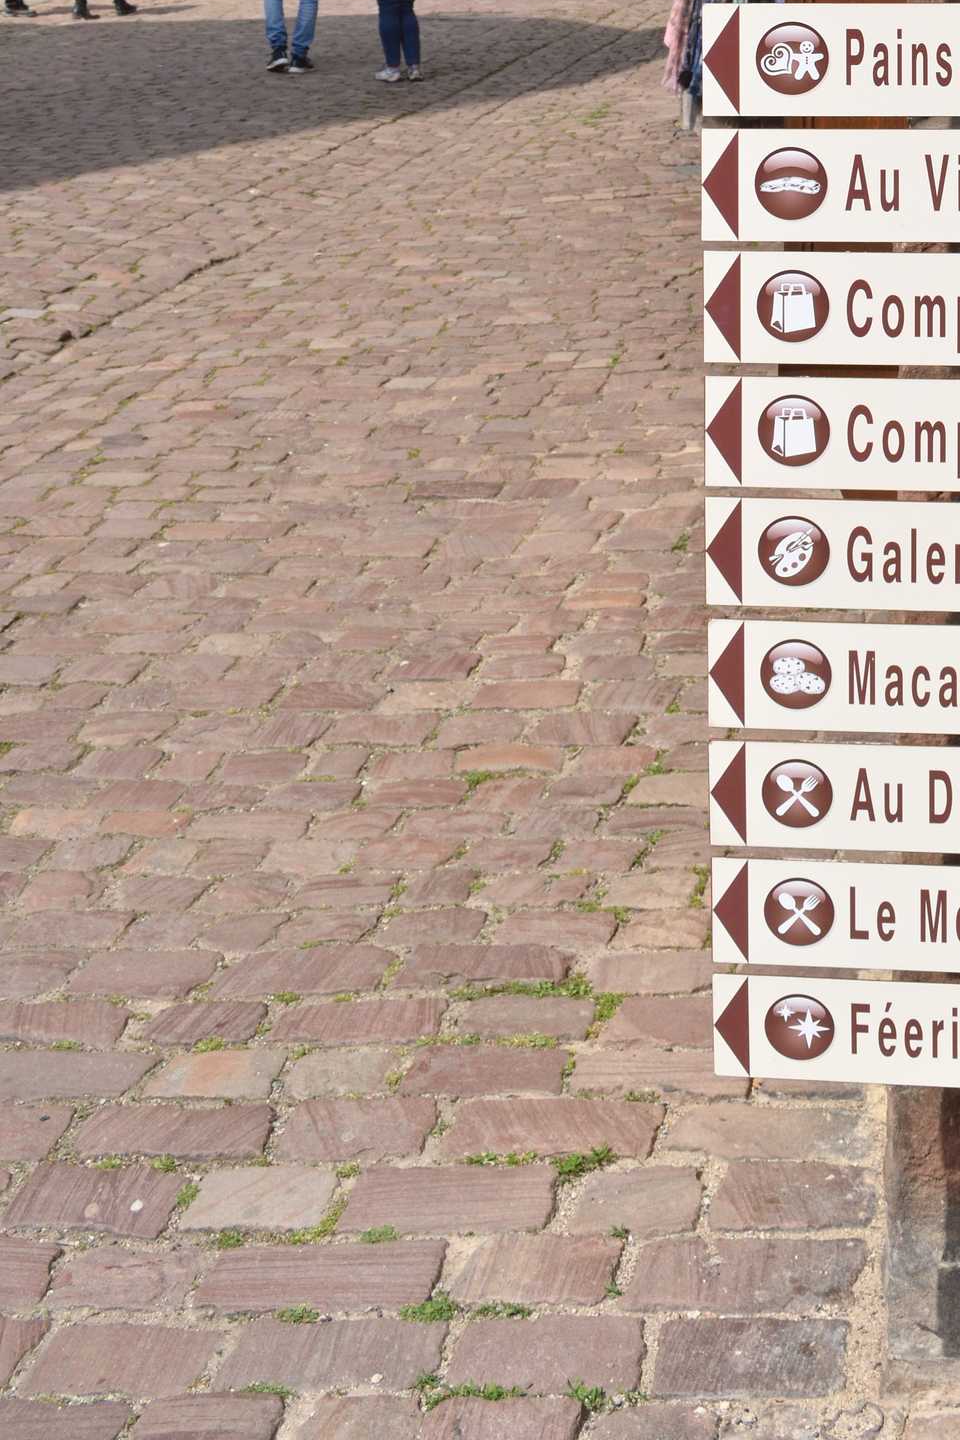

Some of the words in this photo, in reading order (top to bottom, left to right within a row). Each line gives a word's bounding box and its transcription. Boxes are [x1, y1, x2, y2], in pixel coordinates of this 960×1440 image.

[845, 28, 953, 87] Pains
[845, 154, 900, 213] Au
[850, 767, 903, 824] Au
[849, 886, 896, 942] Le
